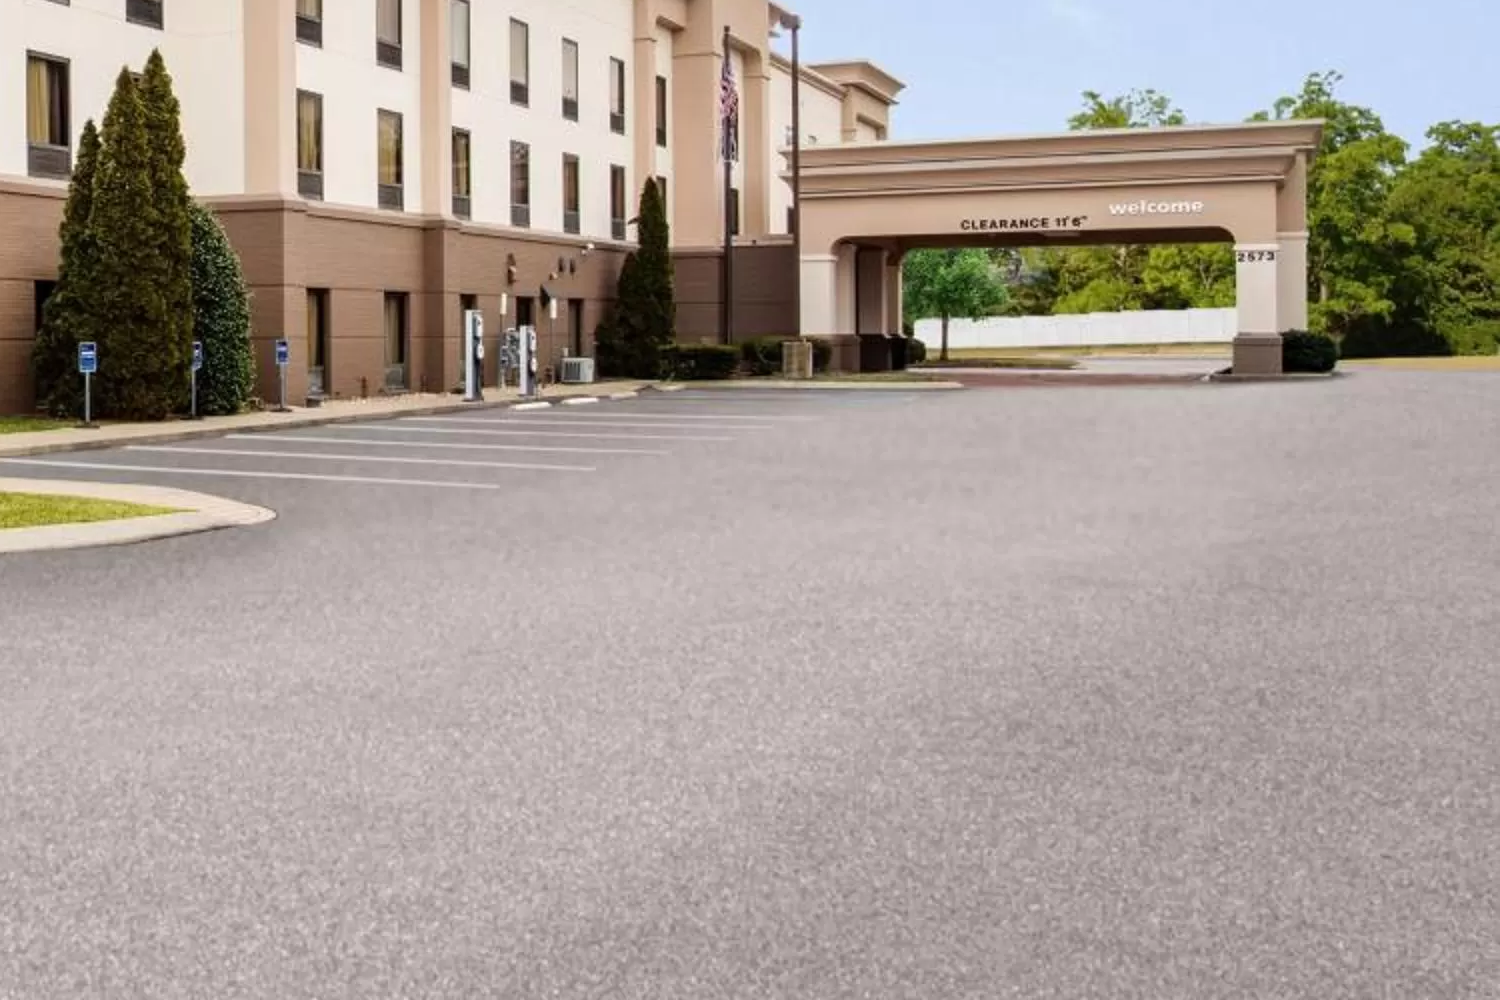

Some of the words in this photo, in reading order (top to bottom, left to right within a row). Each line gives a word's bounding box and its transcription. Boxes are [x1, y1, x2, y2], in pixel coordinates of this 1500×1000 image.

[1108, 200, 1204, 216] welcome
[960, 217, 1050, 231] CLEARANCE
[1237, 251, 1275, 263] 2573
